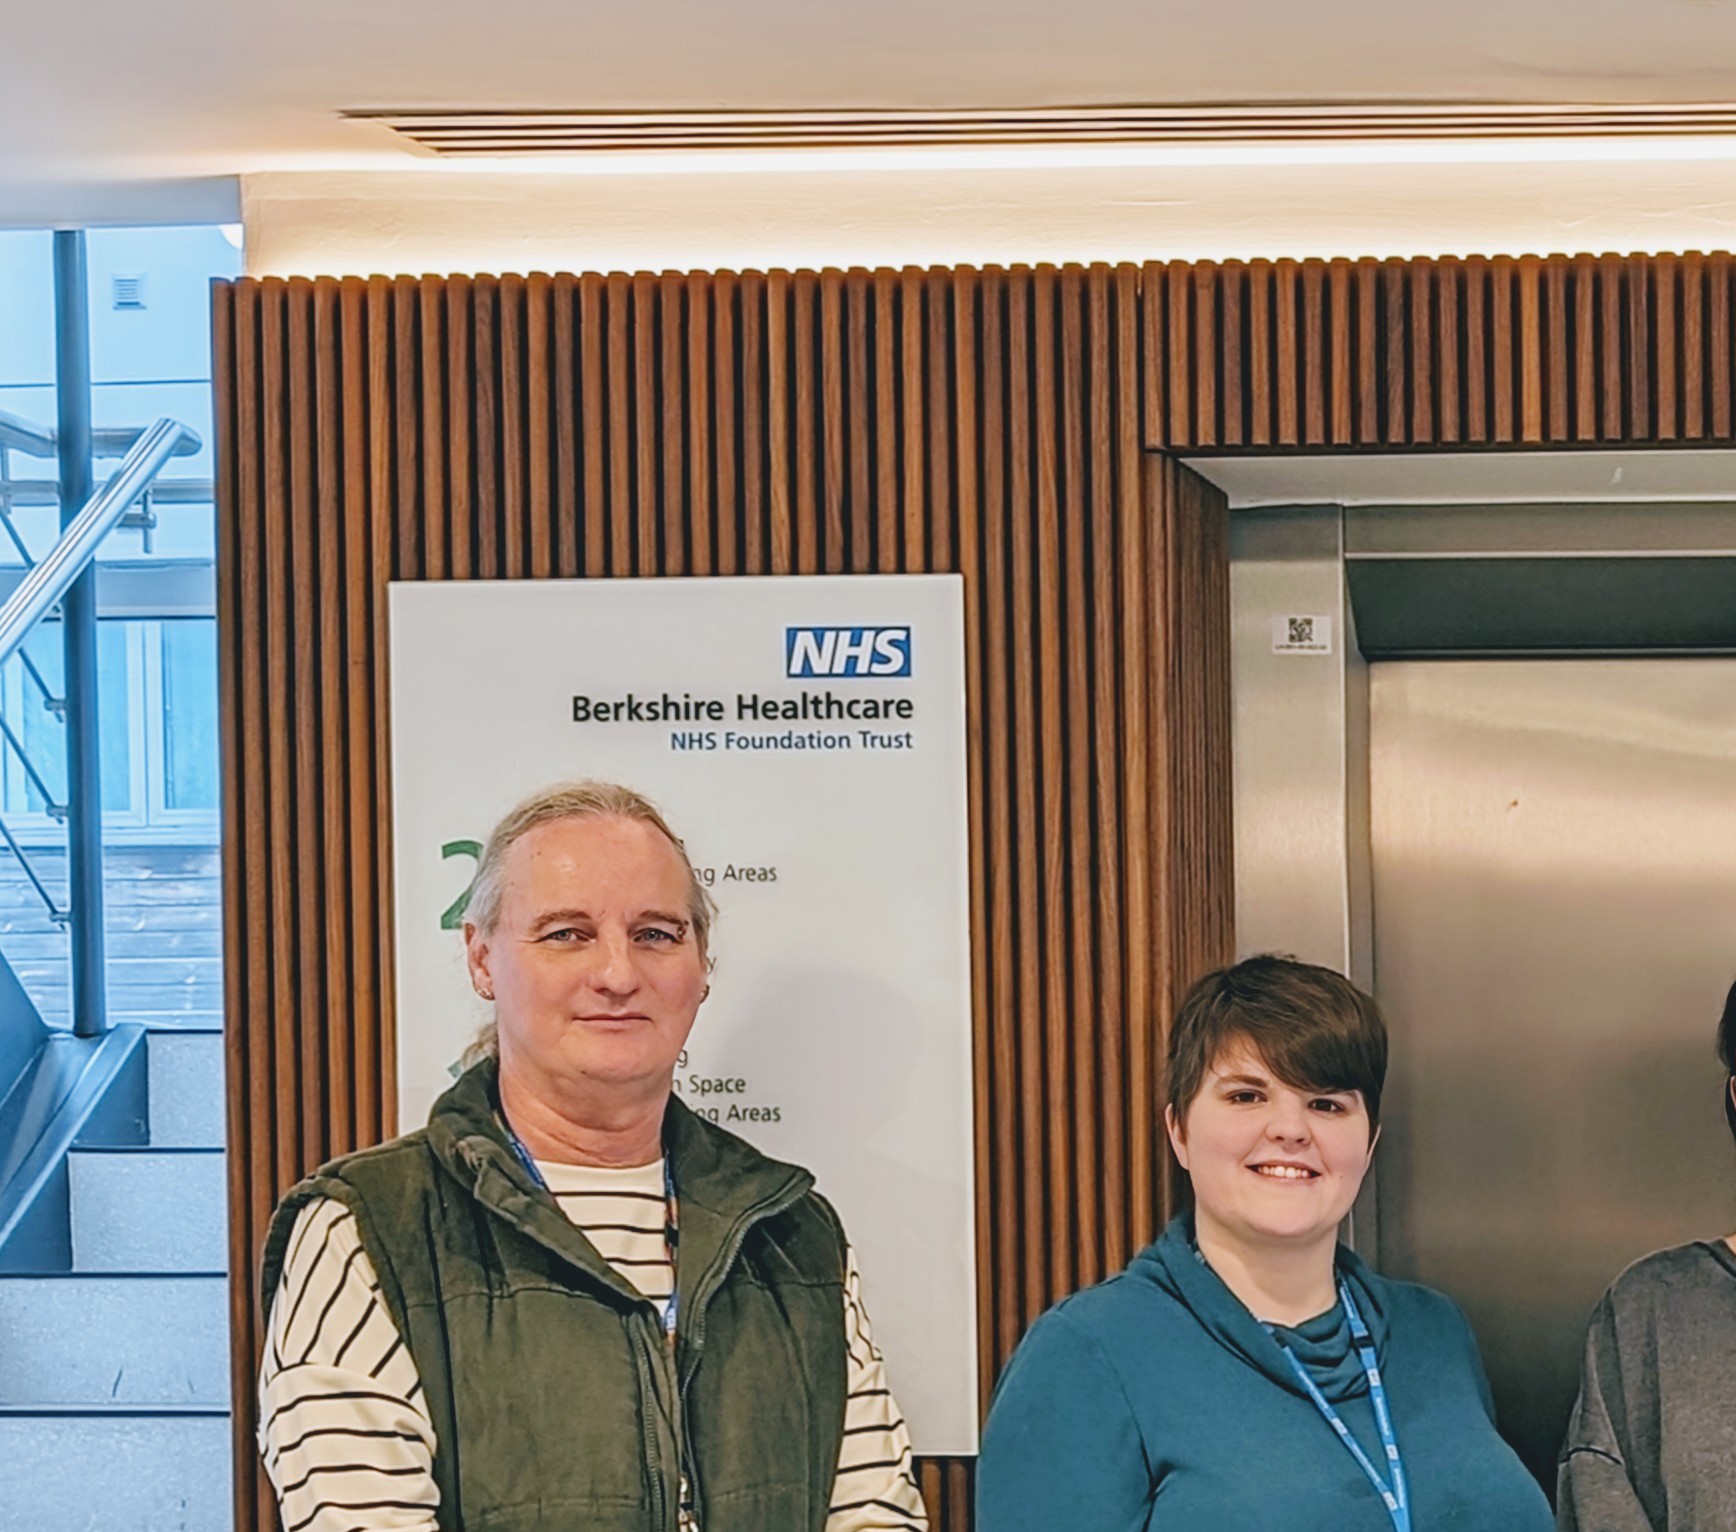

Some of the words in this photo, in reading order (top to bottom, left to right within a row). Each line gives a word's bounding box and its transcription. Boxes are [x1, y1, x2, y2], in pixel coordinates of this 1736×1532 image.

[788, 628, 907, 676] NHS
[572, 693, 725, 723] Berkshire
[736, 691, 914, 721] Healthcare
[671, 732, 717, 750] NHS
[725, 731, 851, 750] Foundation
[858, 731, 913, 749] Trust
[722, 863, 778, 882] Areas
[688, 1074, 747, 1097] Space
[726, 1103, 782, 1123] Areas
